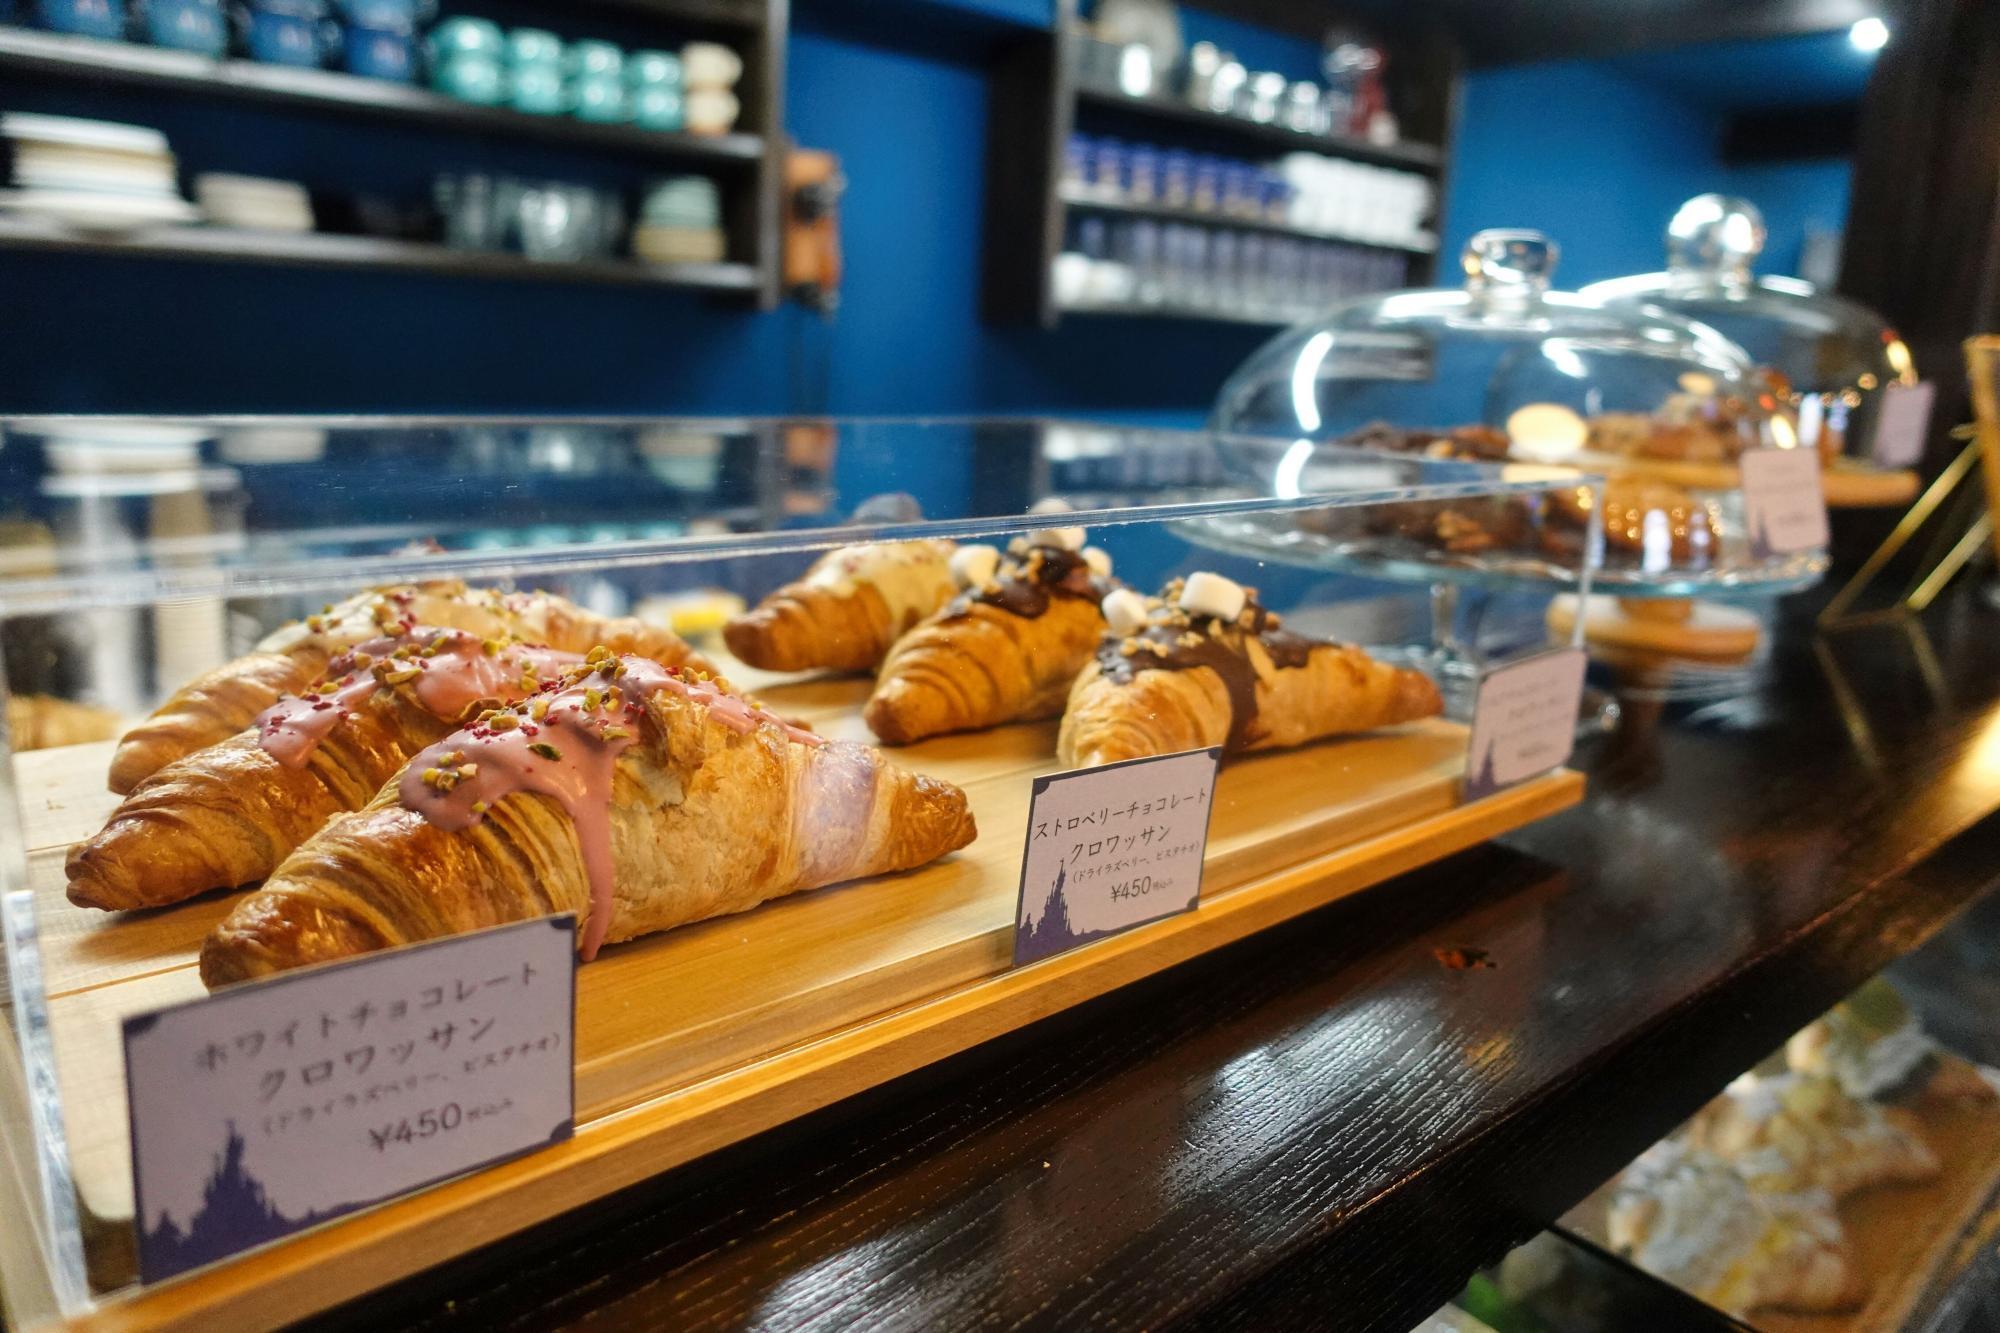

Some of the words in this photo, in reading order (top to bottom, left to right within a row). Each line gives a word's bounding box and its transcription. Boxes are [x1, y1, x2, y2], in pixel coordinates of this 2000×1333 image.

[1033, 786, 1207, 841] ストロベリーチョコレート
[1070, 825, 1172, 865] クロワッサン
[196, 961, 537, 1073] ホワイトチョコレート
[258, 1016, 497, 1105] クロワッサン
